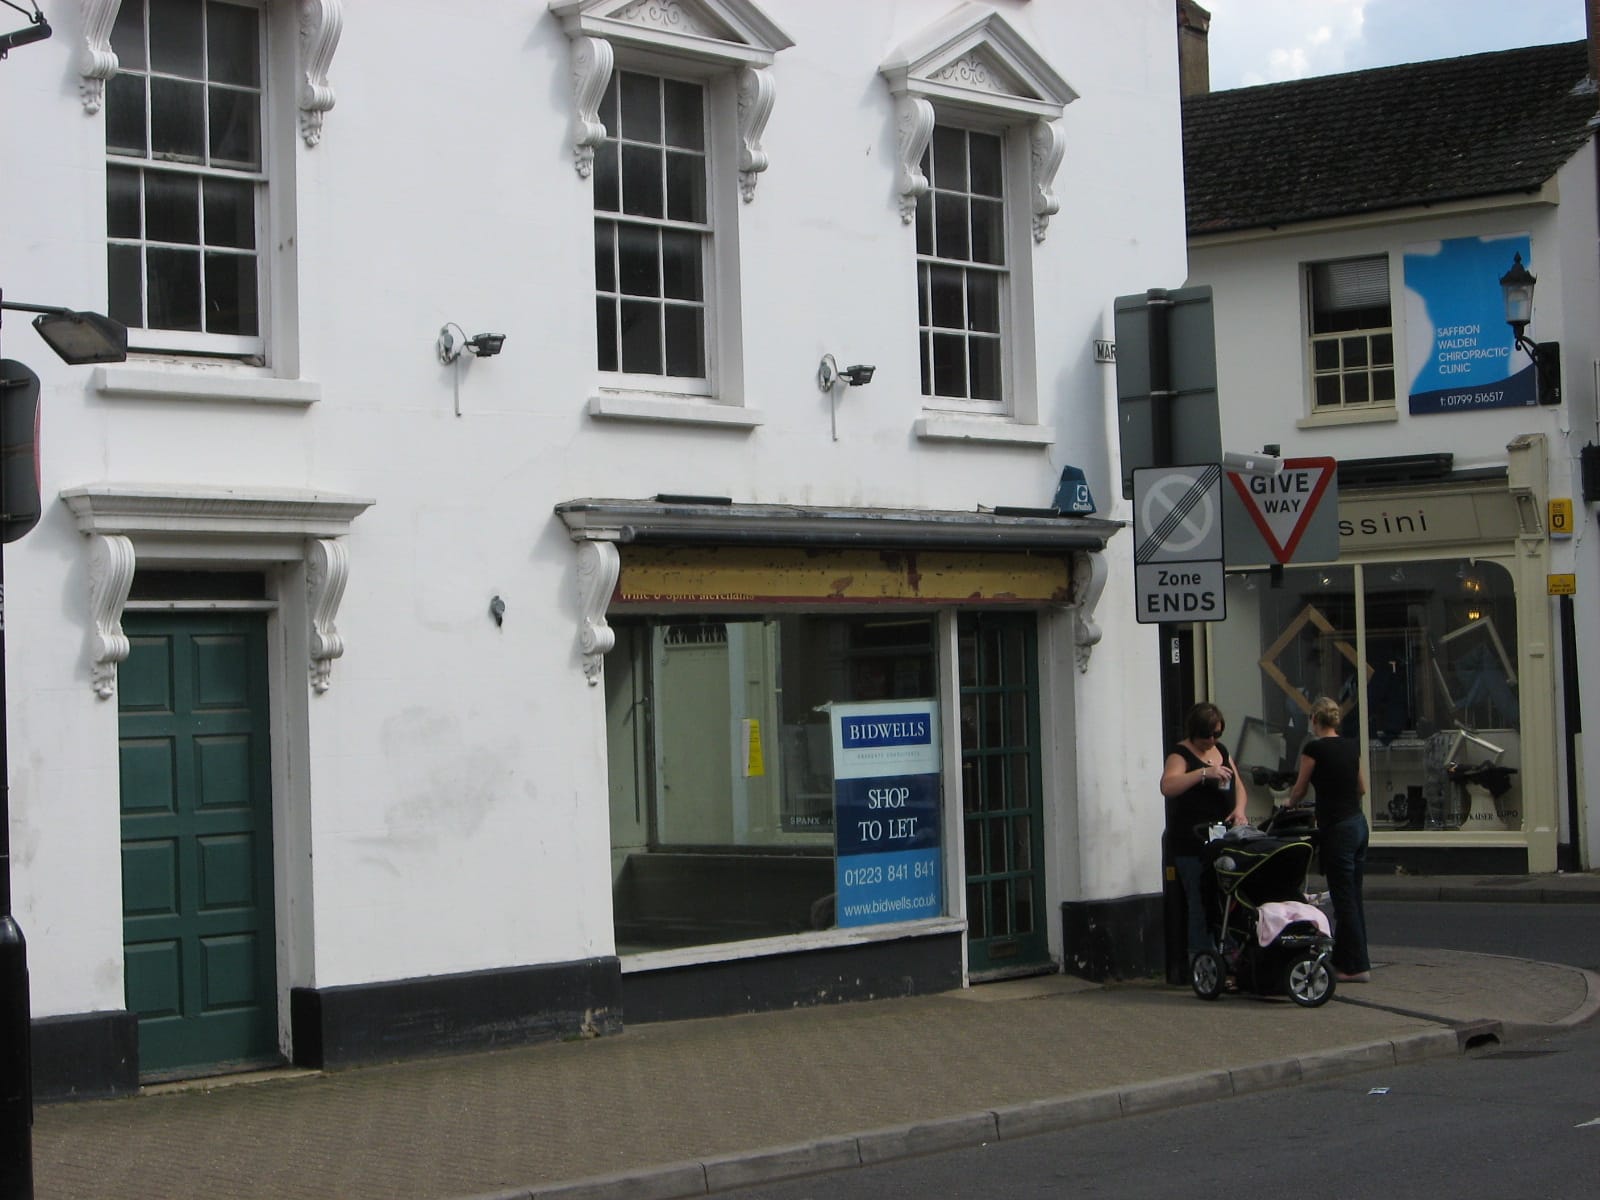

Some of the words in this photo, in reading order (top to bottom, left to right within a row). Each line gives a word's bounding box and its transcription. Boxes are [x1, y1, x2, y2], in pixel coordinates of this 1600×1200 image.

[1437, 325, 1480, 337] SAFFRON
[1438, 338, 1477, 349] WALDEN
[1438, 347, 1509, 362] CHIROPRACTIC
[1439, 363, 1471, 374] CLINIC
[1447, 394, 1473, 406] 01799
[1475, 391, 1504, 403] 516517
[1250, 473, 1309, 494] GIVE
[1264, 500, 1300, 513] WAY
[1339, 510, 1427, 536] ssini
[1158, 571, 1201, 586] Zone
[1147, 592, 1215, 612] ENDS
[849, 721, 925, 739] BIDWELLS
[868, 787, 909, 809] SHOP
[858, 820, 882, 841] TO
[888, 817, 918, 839] LET
[844, 866, 882, 886] 01223
[887, 863, 908, 881] 841
[914, 860, 934, 879] 841
[844, 893, 936, 916] www.bidwells.co.uk
